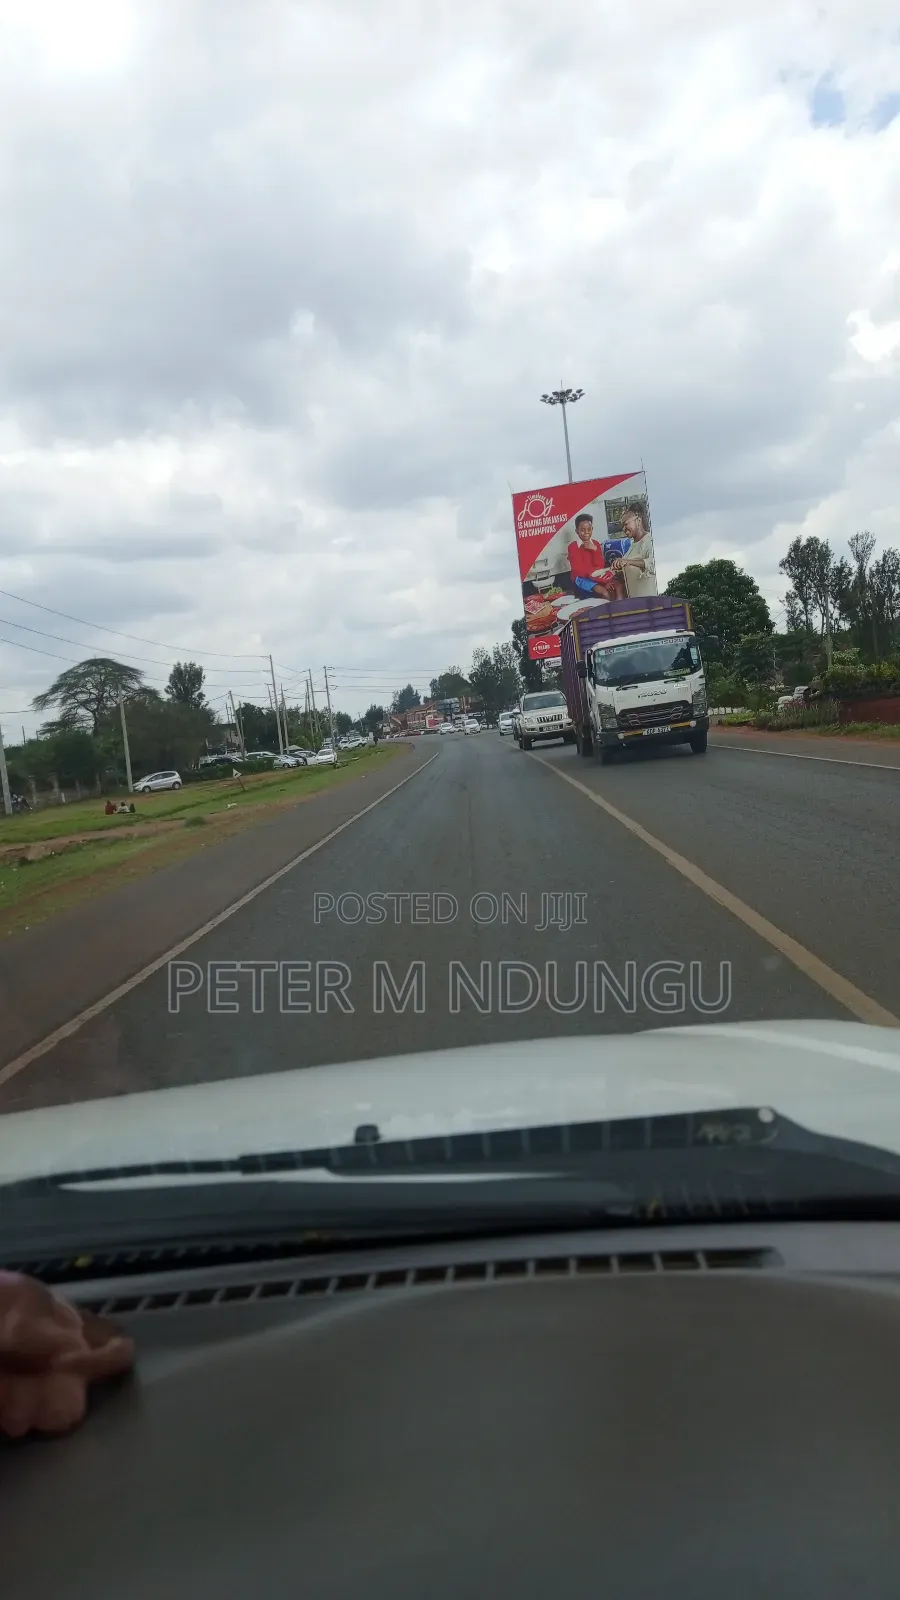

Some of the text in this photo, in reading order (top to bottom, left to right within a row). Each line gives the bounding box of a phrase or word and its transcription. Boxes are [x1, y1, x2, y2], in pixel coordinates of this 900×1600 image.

[524, 518, 542, 528] MAKING
[543, 514, 568, 525] BREAKFAST
[519, 525, 556, 538] FOR CHAMPIONS
[638, 688, 667, 698] ISUZU
